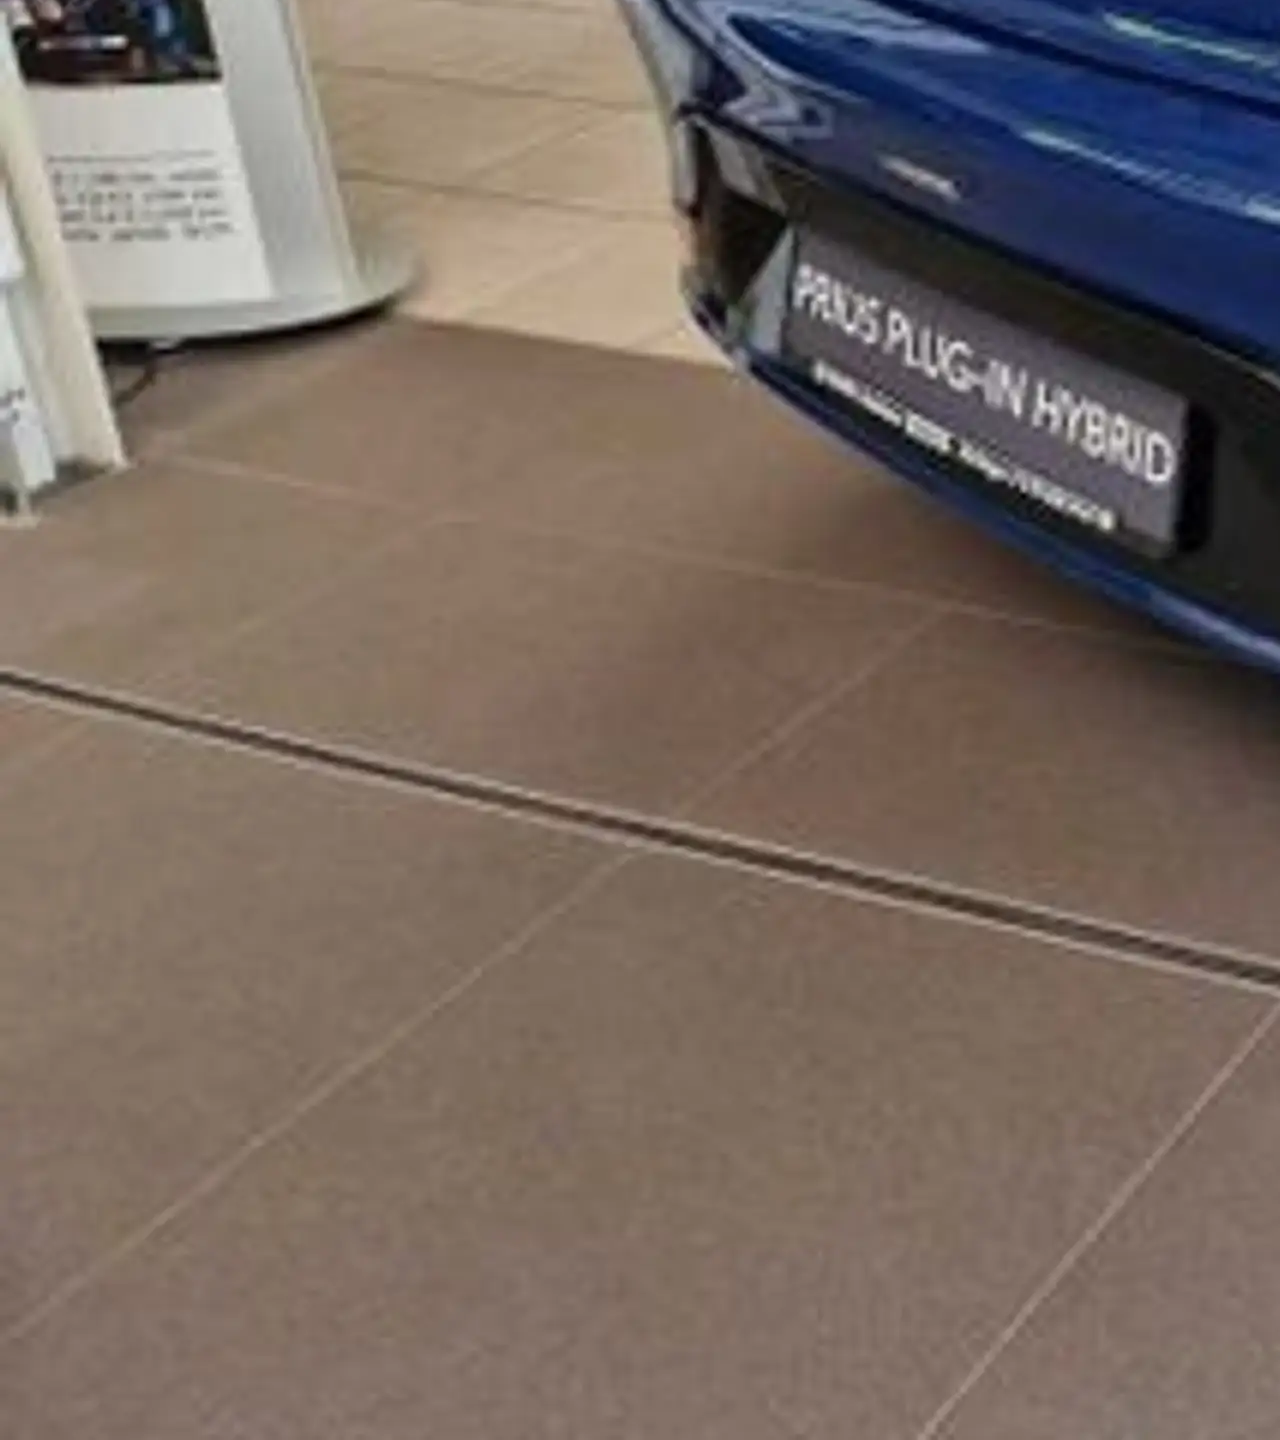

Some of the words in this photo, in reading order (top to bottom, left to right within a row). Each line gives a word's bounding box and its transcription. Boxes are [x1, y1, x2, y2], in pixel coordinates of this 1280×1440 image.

[793, 263, 881, 346] PRIUS
[882, 306, 1029, 420] PLUG-IN
[1031, 378, 1178, 485] HYBRID
